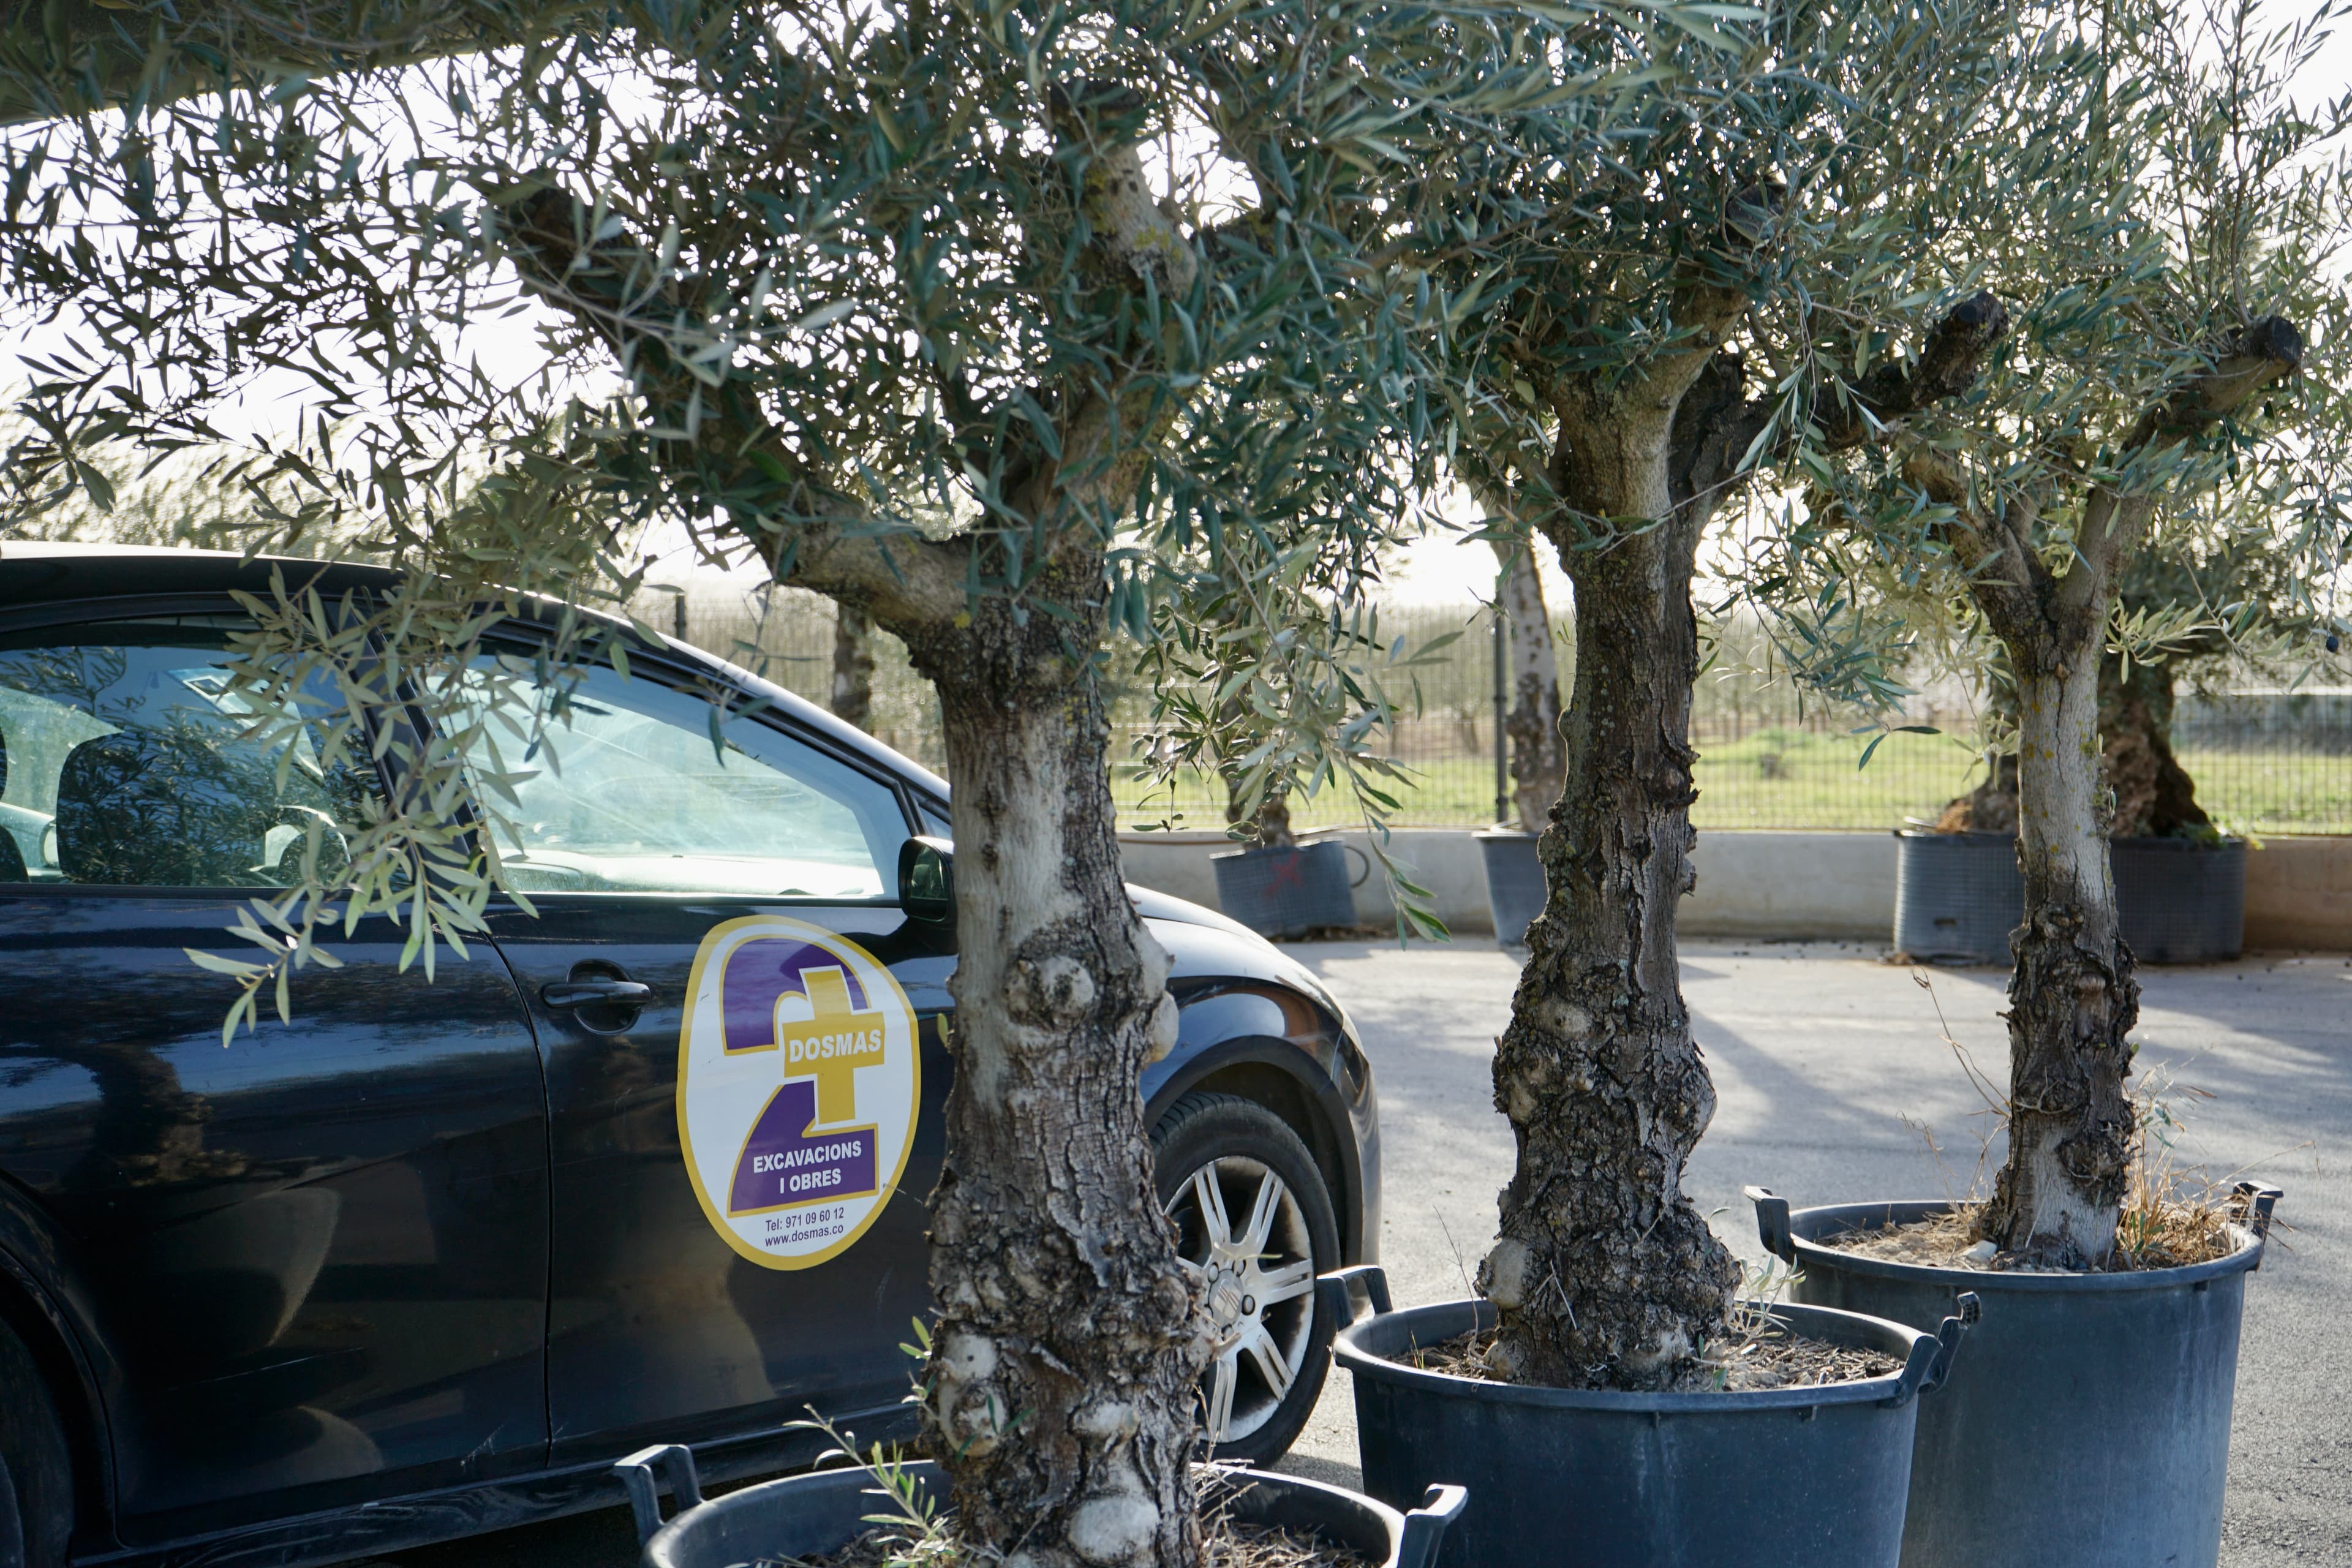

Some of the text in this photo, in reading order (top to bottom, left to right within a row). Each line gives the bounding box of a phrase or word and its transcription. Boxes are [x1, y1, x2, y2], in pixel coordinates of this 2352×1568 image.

[789, 1029, 881, 1063] DOSMAS
[753, 1140, 862, 1173] EXCAVACIONS
[780, 1168, 841, 1194] I OBRES
[766, 1207, 844, 1232] Tel: 971 09 60 12
[765, 1224, 843, 1246] www.dosmas.co
